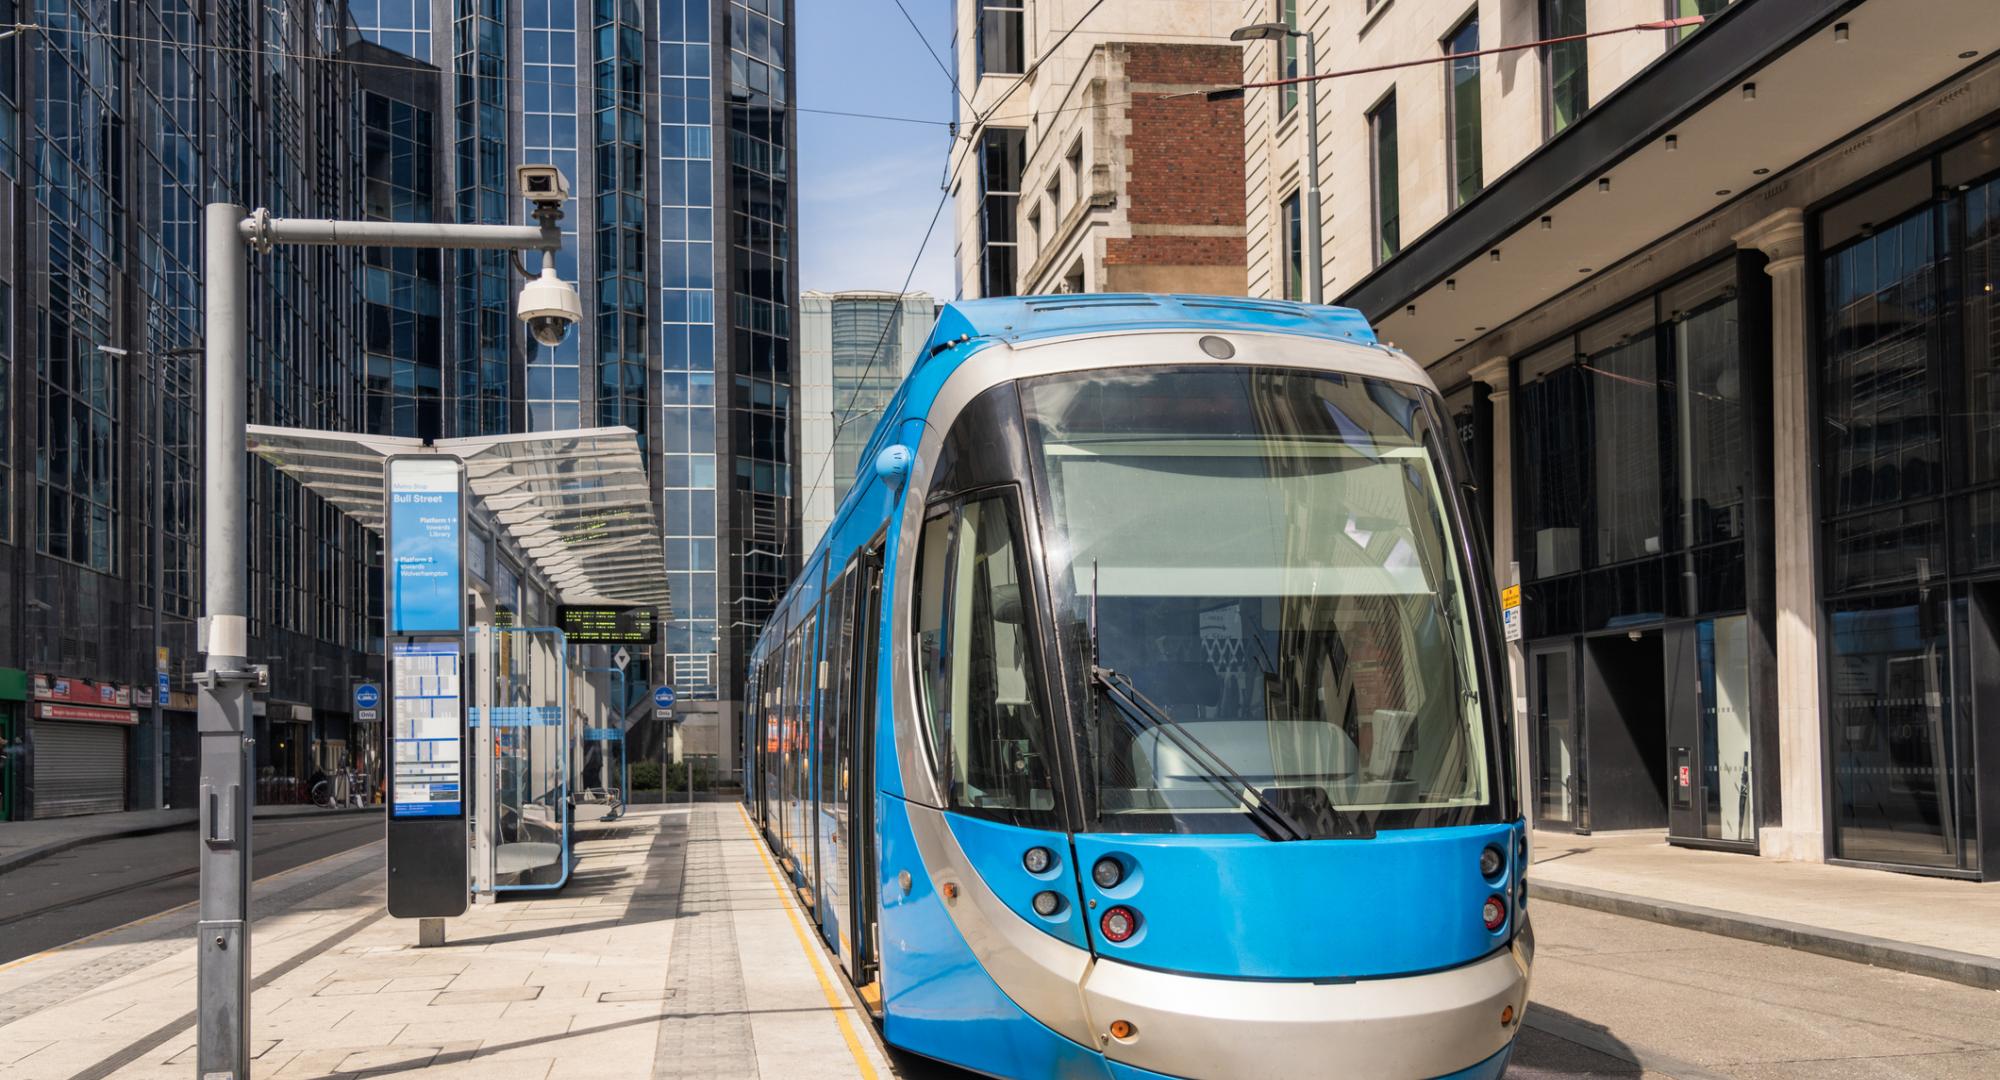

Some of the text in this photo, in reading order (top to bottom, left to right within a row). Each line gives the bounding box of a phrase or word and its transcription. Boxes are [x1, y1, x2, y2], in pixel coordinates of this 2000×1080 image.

[393, 494, 443, 503] Bull Street
[361, 711, 374, 719] Only
